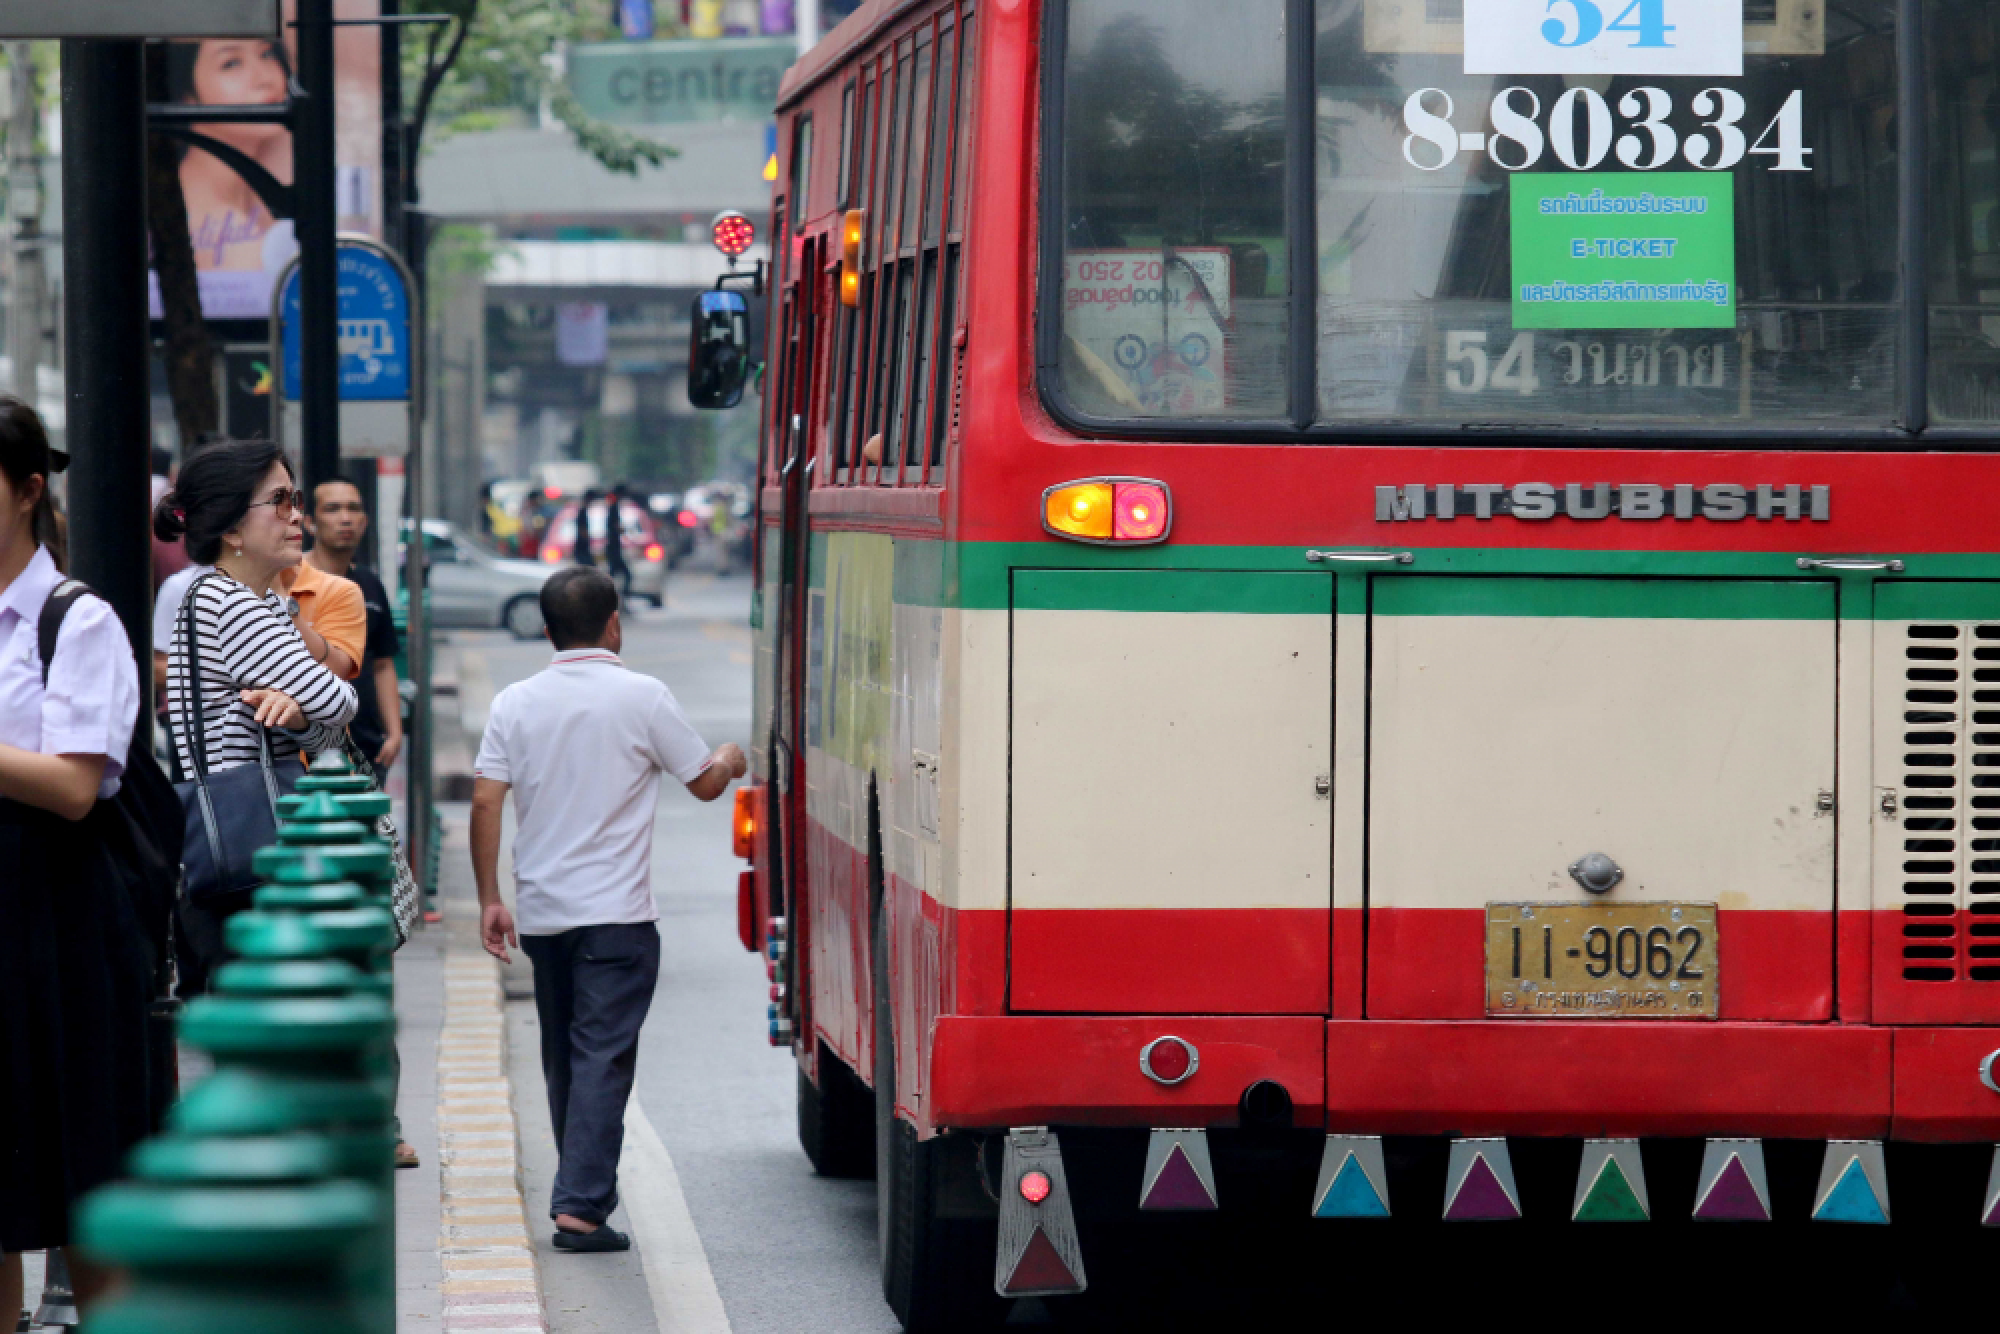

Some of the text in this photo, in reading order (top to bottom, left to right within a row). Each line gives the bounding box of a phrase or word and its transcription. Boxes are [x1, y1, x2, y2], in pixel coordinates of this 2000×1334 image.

[1541, 0, 1676, 48] 54
[608, 56, 784, 105] centra
[1402, 86, 1813, 171] 8-80334
[1539, 188, 1708, 214] รถคันนี้รองรับระบบ
[1571, 238, 1678, 258] E-TICKET
[1520, 278, 1728, 306] และบัตรสวัสดิการแห่งรัฐ
[1445, 331, 1540, 395] 54
[1375, 481, 1831, 521] MITSUBISHI
[1511, 924, 1704, 980] 11-9062
